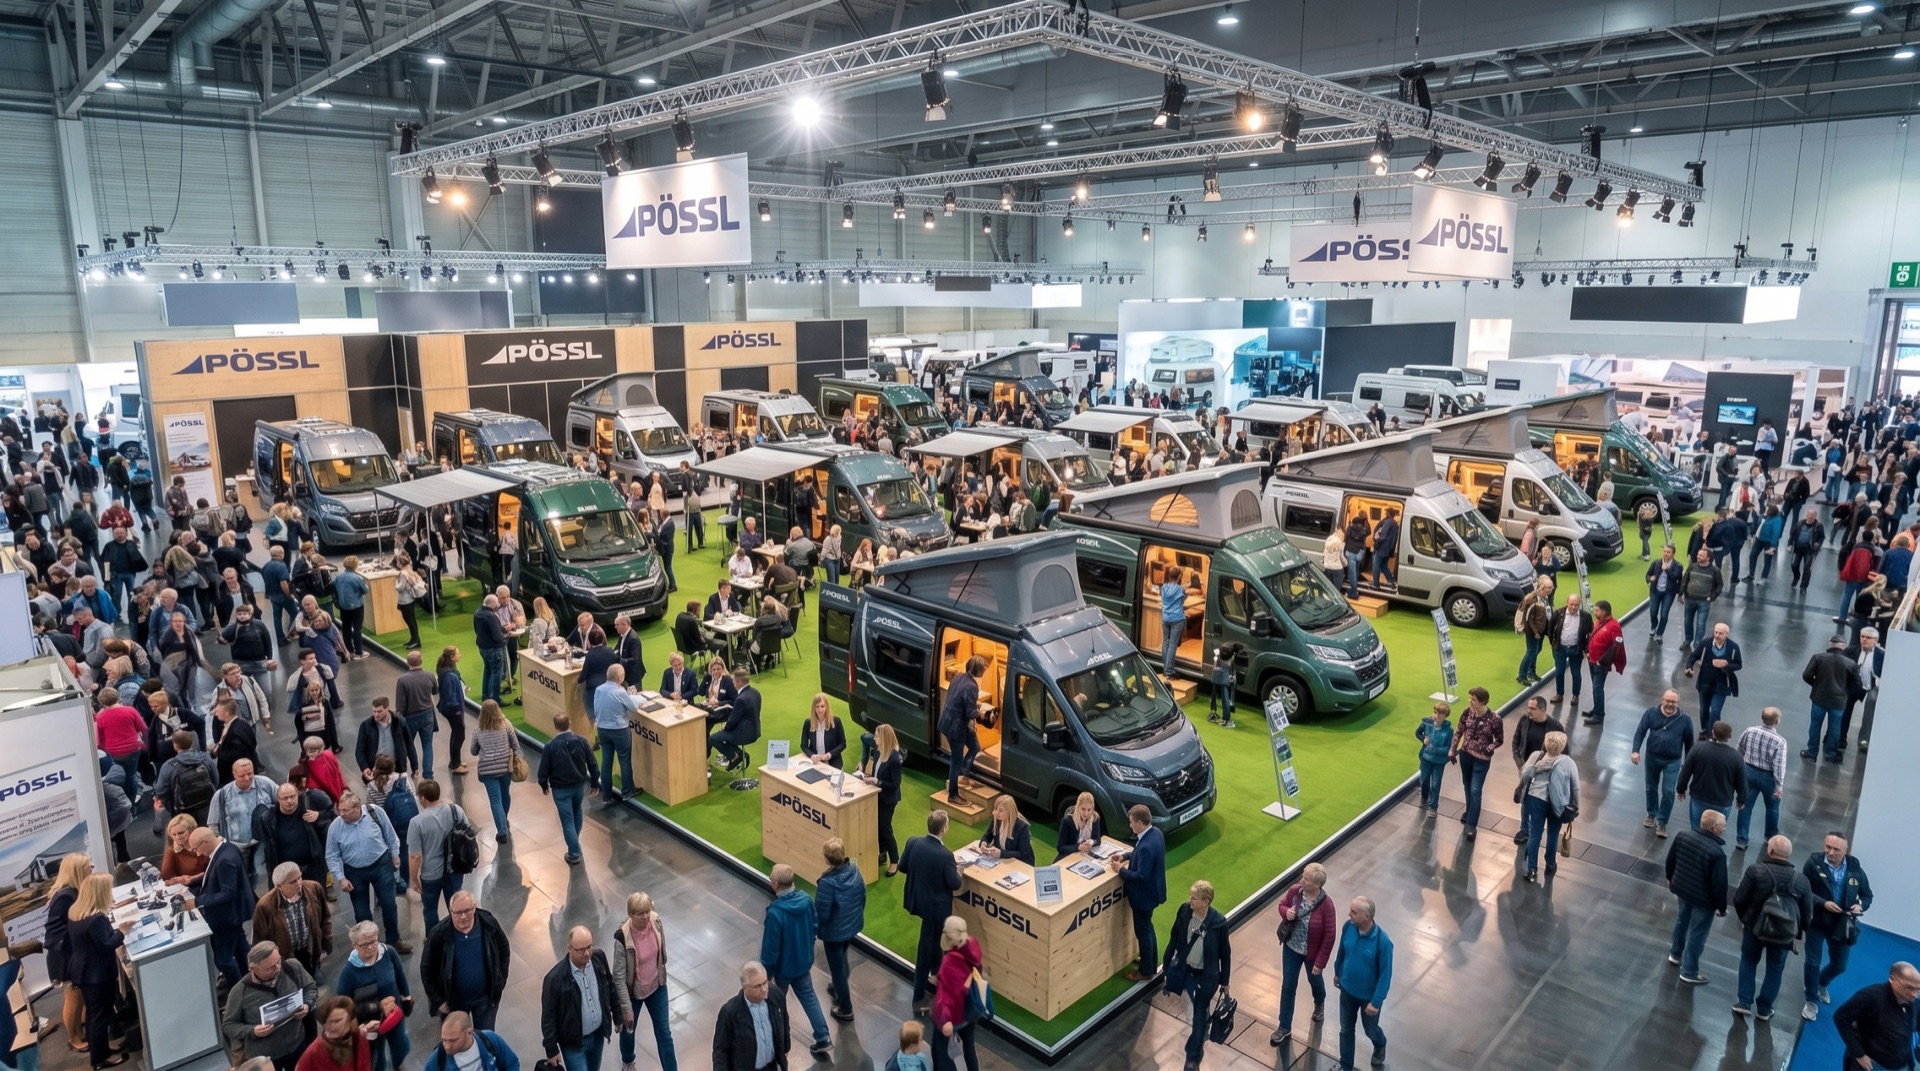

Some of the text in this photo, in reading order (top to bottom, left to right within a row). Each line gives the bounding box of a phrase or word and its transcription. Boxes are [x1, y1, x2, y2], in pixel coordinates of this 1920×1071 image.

[637, 193, 740, 237] PÖSSL
[1440, 213, 1509, 254] PÖSSL
[507, 339, 603, 364] PÖSSL
[717, 330, 782, 349] PÖSSL
[204, 348, 320, 373] PÖSSL
[533, 670, 562, 694] PÖSSL
[782, 792, 832, 830] PÖSSL
[971, 892, 1039, 940] PÖSSL
